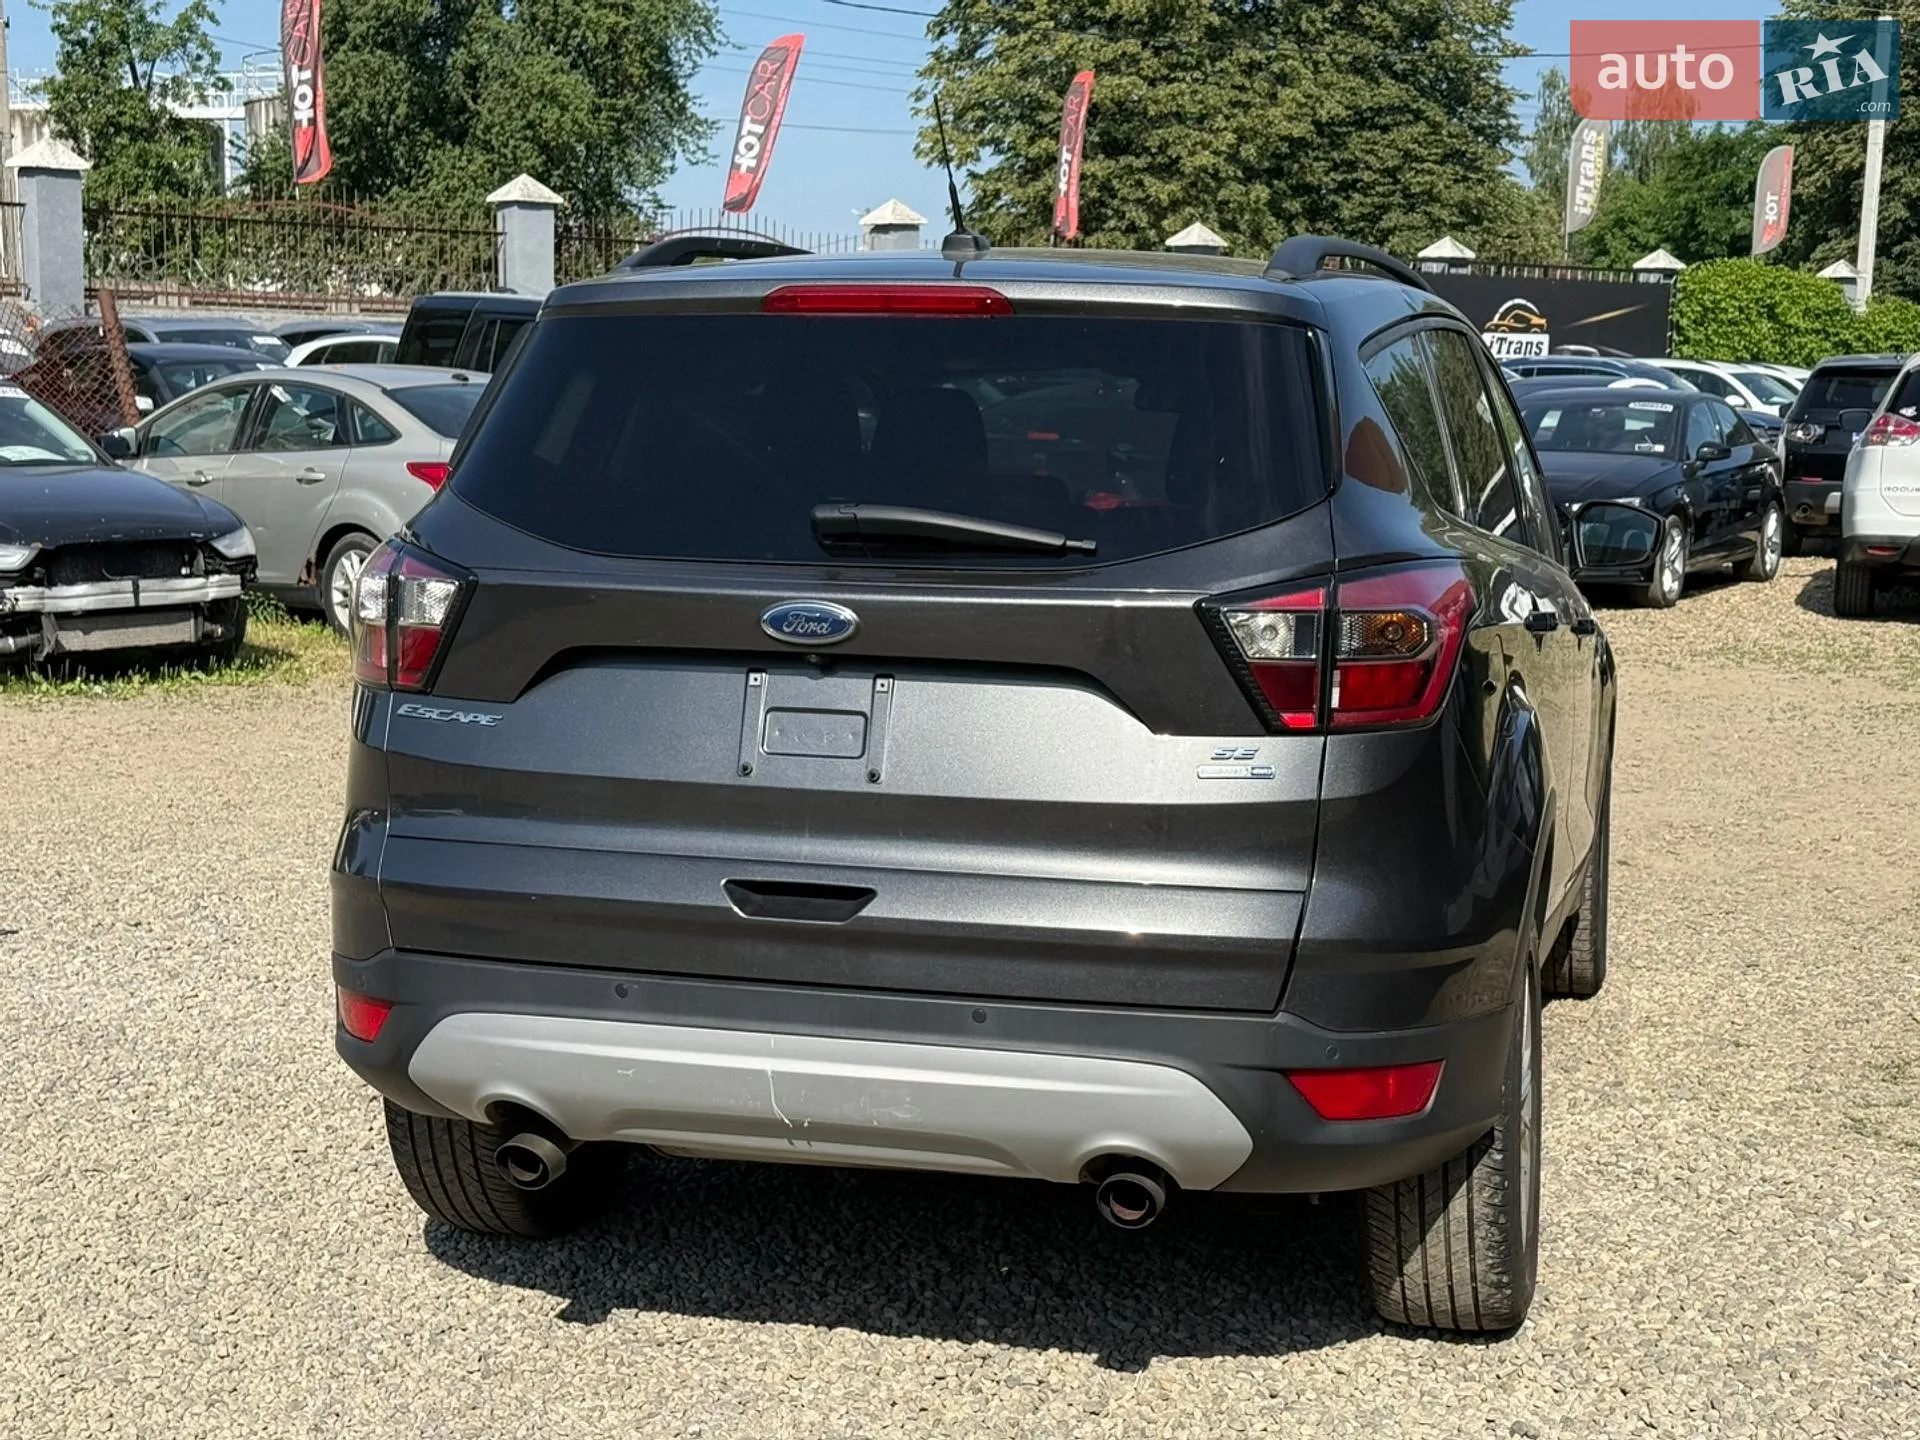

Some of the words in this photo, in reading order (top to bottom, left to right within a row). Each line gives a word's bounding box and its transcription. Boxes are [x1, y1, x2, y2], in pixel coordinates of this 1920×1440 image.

[1574, 127, 1598, 216] iTrans
[1489, 335, 1545, 357] iTrans
[782, 610, 833, 635] Ford
[397, 703, 503, 726] ESCAPE
[1211, 747, 1260, 760] SE
